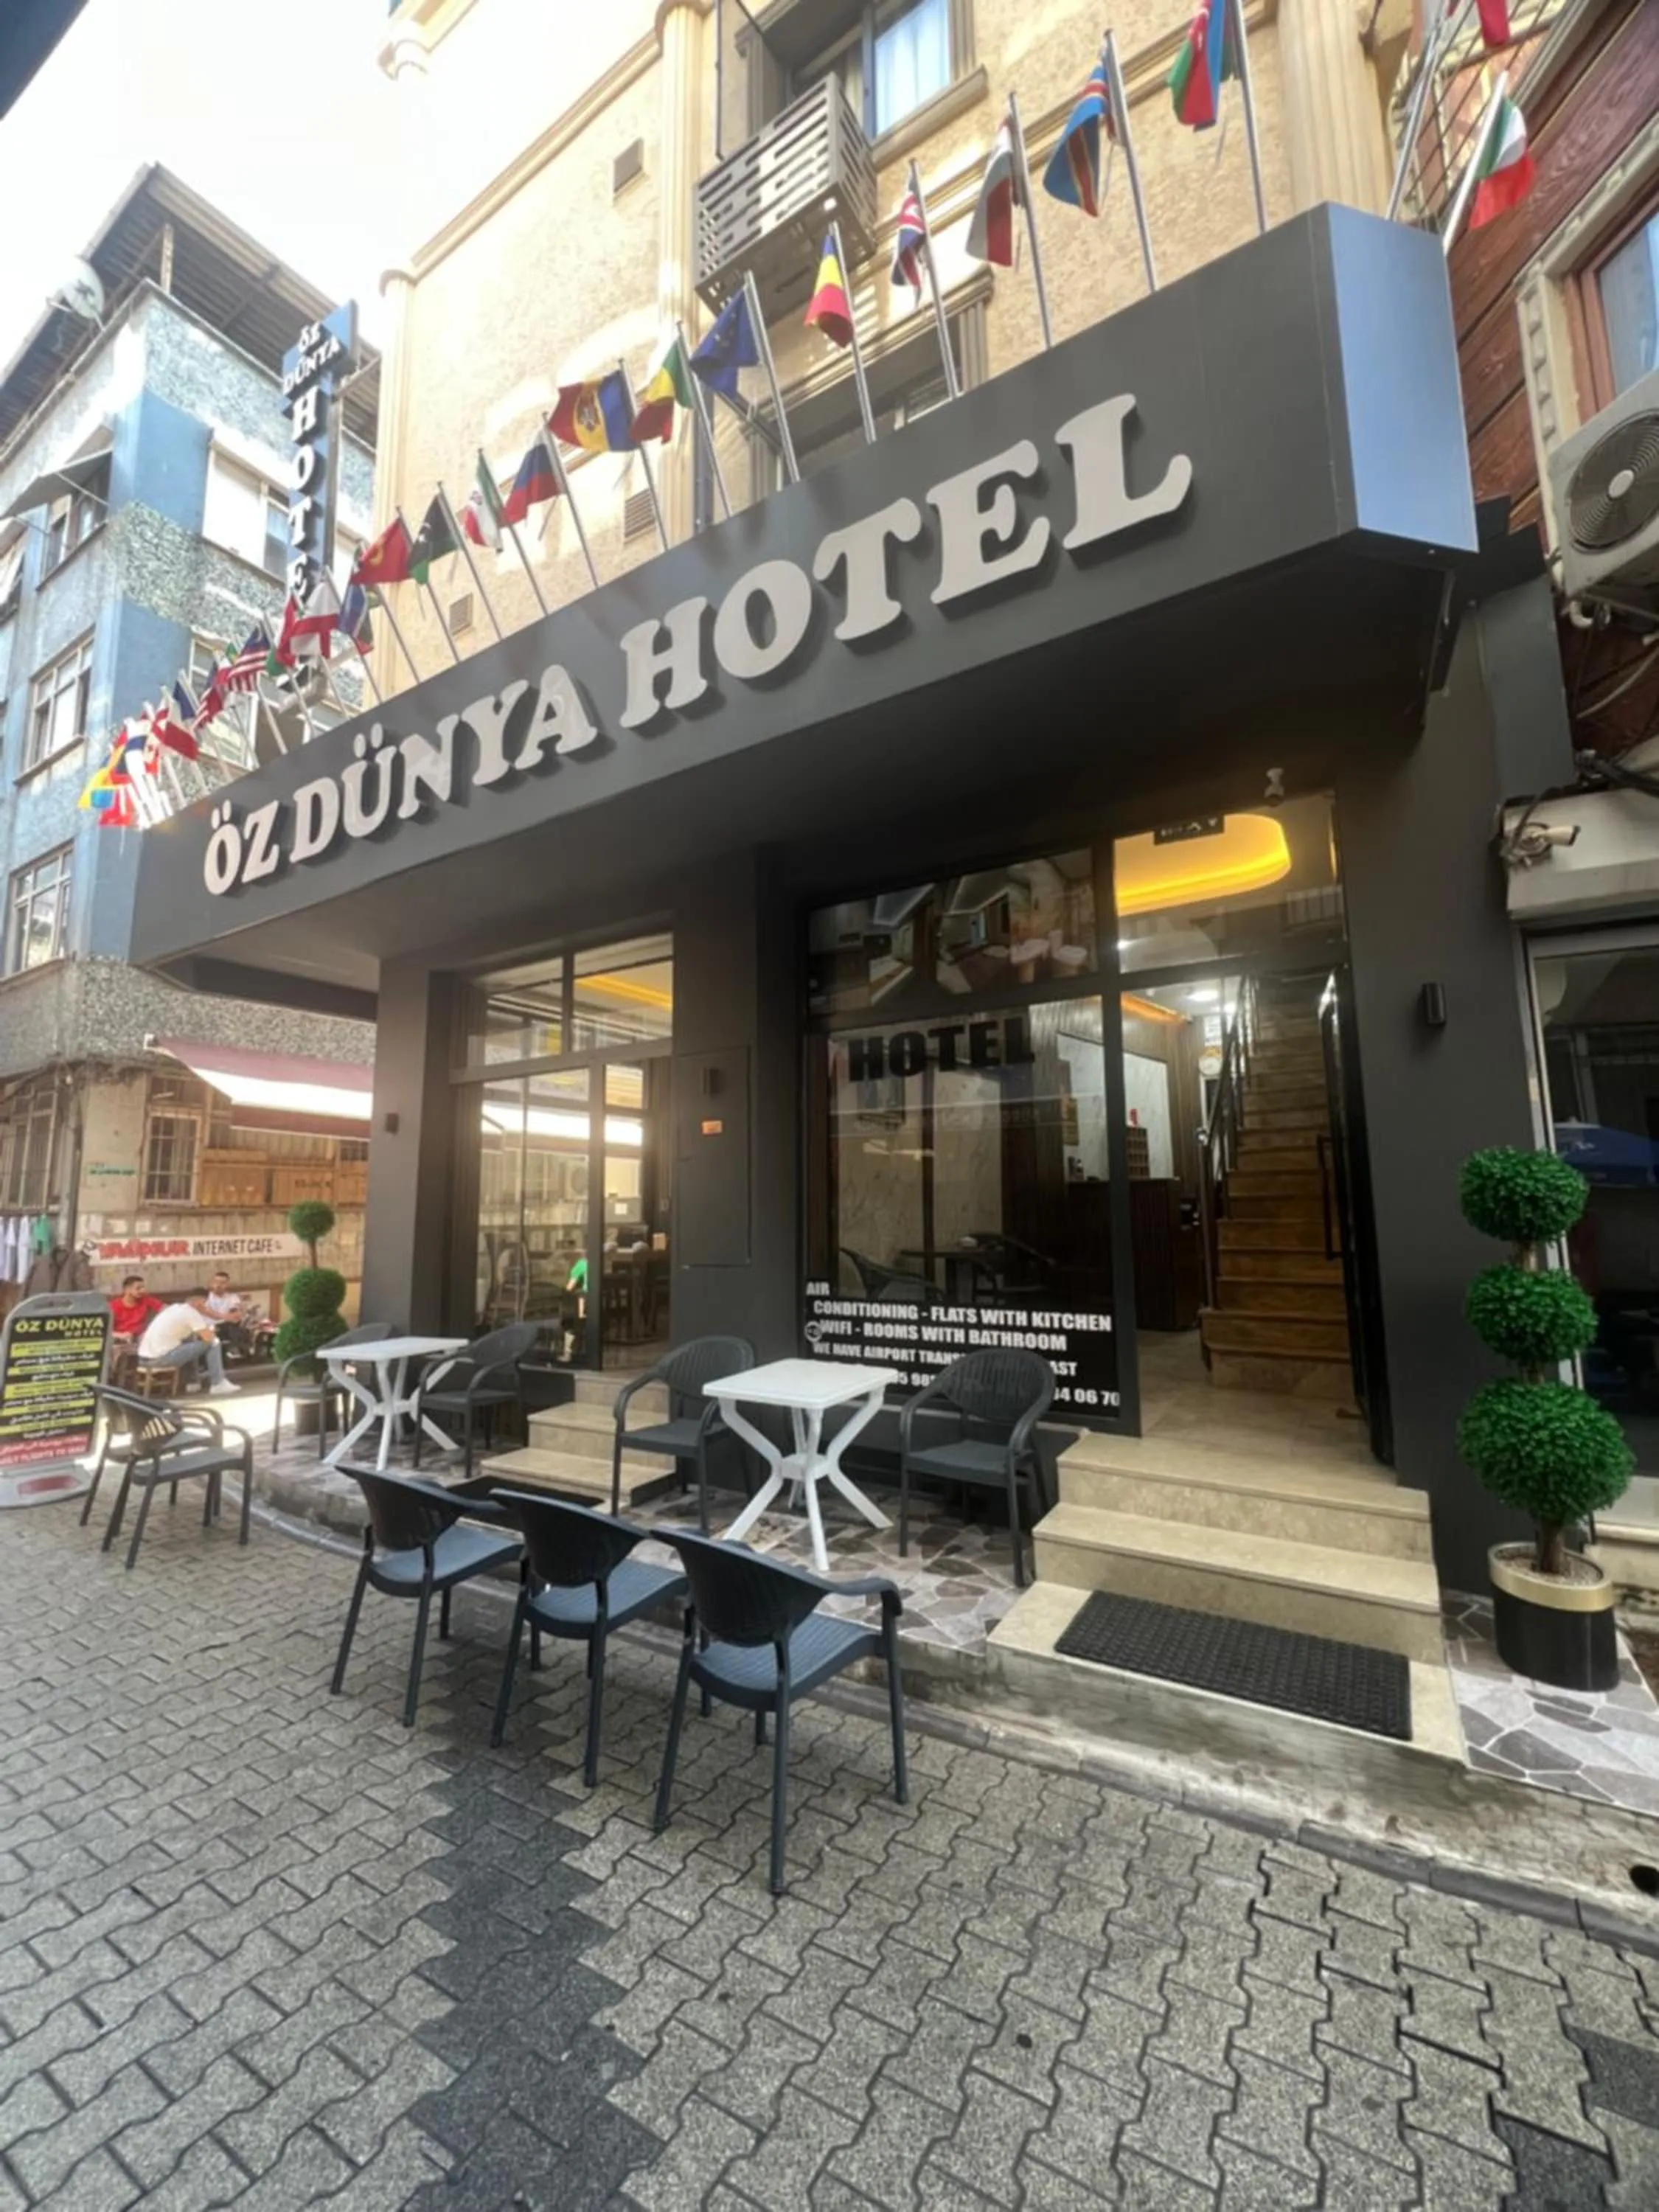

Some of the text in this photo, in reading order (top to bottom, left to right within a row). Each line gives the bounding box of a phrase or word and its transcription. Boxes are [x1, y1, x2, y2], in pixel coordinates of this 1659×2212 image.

[282, 335, 340, 396] DÜNYA
[204, 393, 1192, 895] ÖZ DÜNYA HOTEL
[848, 1018, 1035, 1082] HOTEL
[192, 1239, 246, 1256] INTERNET
[248, 1238, 273, 1253] CAFE
[806, 1281, 830, 1295] AIR
[813, 1300, 919, 1320] CONDITIONING
[931, 1306, 978, 1324] FLATS
[980, 1308, 1028, 1326] WITH
[1032, 1311, 1112, 1332] KITCHEN
[819, 1318, 852, 1336] WIFI
[863, 1321, 919, 1340] ROOMS
[922, 1325, 965, 1343] WITH
[968, 1329, 1067, 1351] BATHROOM
[813, 1342, 830, 1354] WE
[832, 1343, 862, 1357] HAVE
[863, 1345, 915, 1363] AIRPORT
[918, 1349, 966, 1366] TRAN
[1074, 1387, 1098, 1405] 06
[1100, 1390, 1120, 1408] 70
